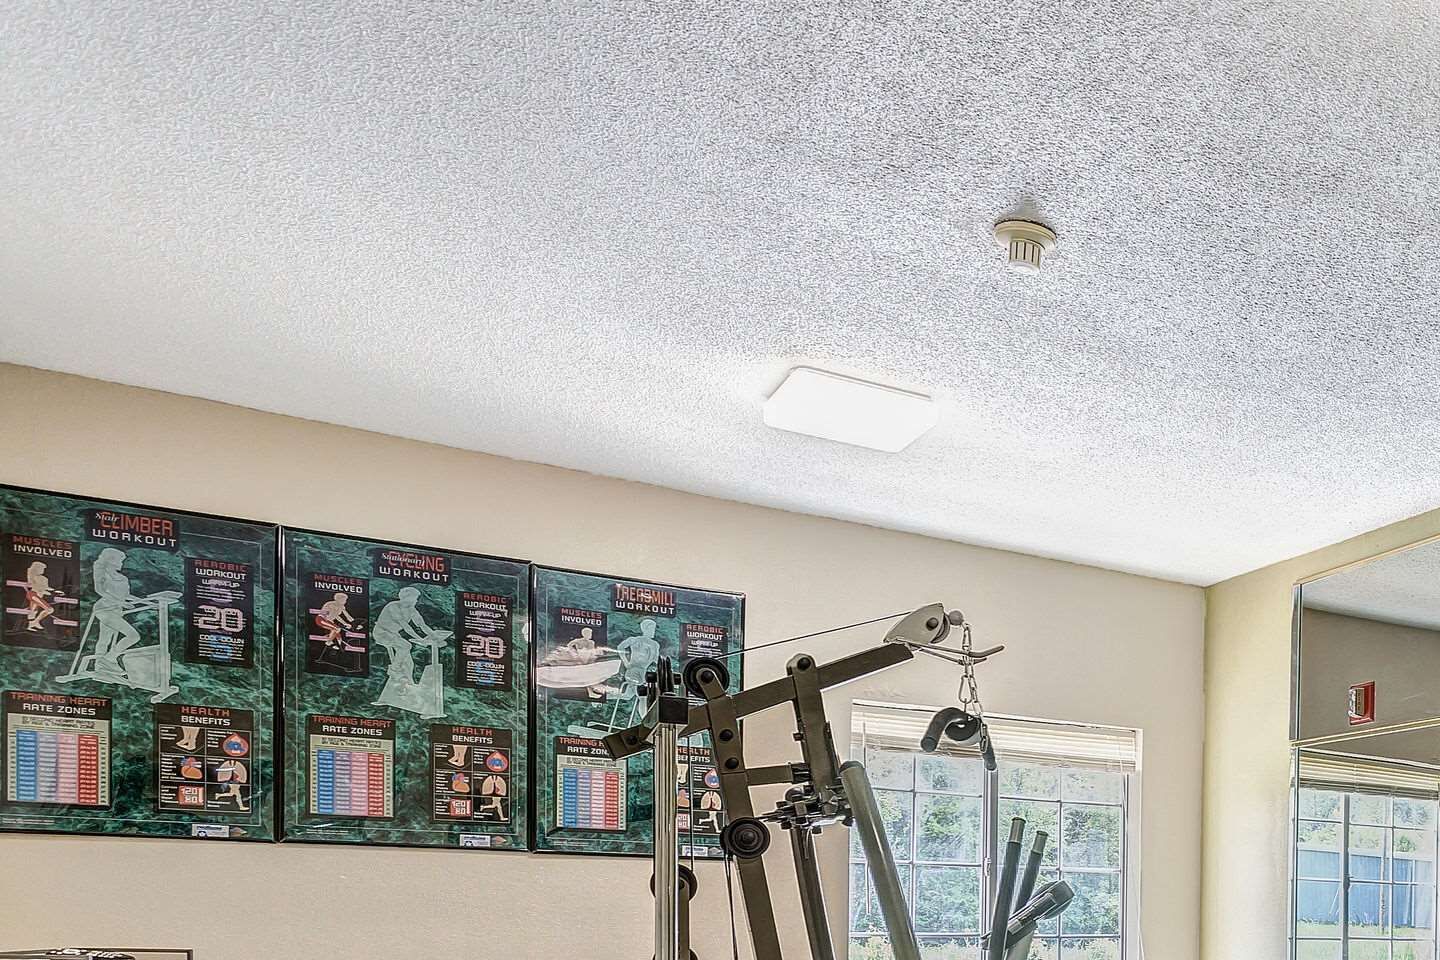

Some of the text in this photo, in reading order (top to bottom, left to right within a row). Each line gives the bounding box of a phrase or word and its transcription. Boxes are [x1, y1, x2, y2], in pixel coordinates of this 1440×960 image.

[101, 511, 173, 536] CLIMBER
[12, 535, 73, 550] MUSCLES
[92, 528, 177, 548] WORKOUT
[13, 544, 73, 558] INVOLVED
[194, 559, 248, 572] AEROBIC
[388, 551, 445, 572] CYCLING
[195, 567, 247, 580] WORKOUT
[314, 573, 363, 585] MUSCLES
[379, 566, 449, 582] WORKOUT
[314, 581, 363, 593] INVOLVED
[463, 592, 506, 604] AEROBIC
[614, 583, 676, 606] TREADMILL
[464, 600, 507, 611] WORKOUT
[615, 600, 674, 615] WORKOUT
[197, 604, 244, 633] 20
[561, 607, 602, 619] MUSCLES
[561, 614, 602, 626] INVOLVED
[686, 624, 723, 635] AEROBIC
[687, 631, 723, 641] WORKOUT
[466, 634, 504, 659] 20
[10, 691, 109, 707] TRAINING HEART
[23, 703, 96, 716] RATE ZONES
[181, 706, 230, 717] HEALTH
[181, 715, 231, 726] BENEFITS
[312, 715, 392, 728] TRAINING HEART
[322, 725, 383, 736] RATE ZONES
[452, 727, 493, 736] HEALTH
[452, 735, 493, 744] BENEFITS
[559, 737, 597, 746] TRAINING
[567, 746, 588, 754] RATE
